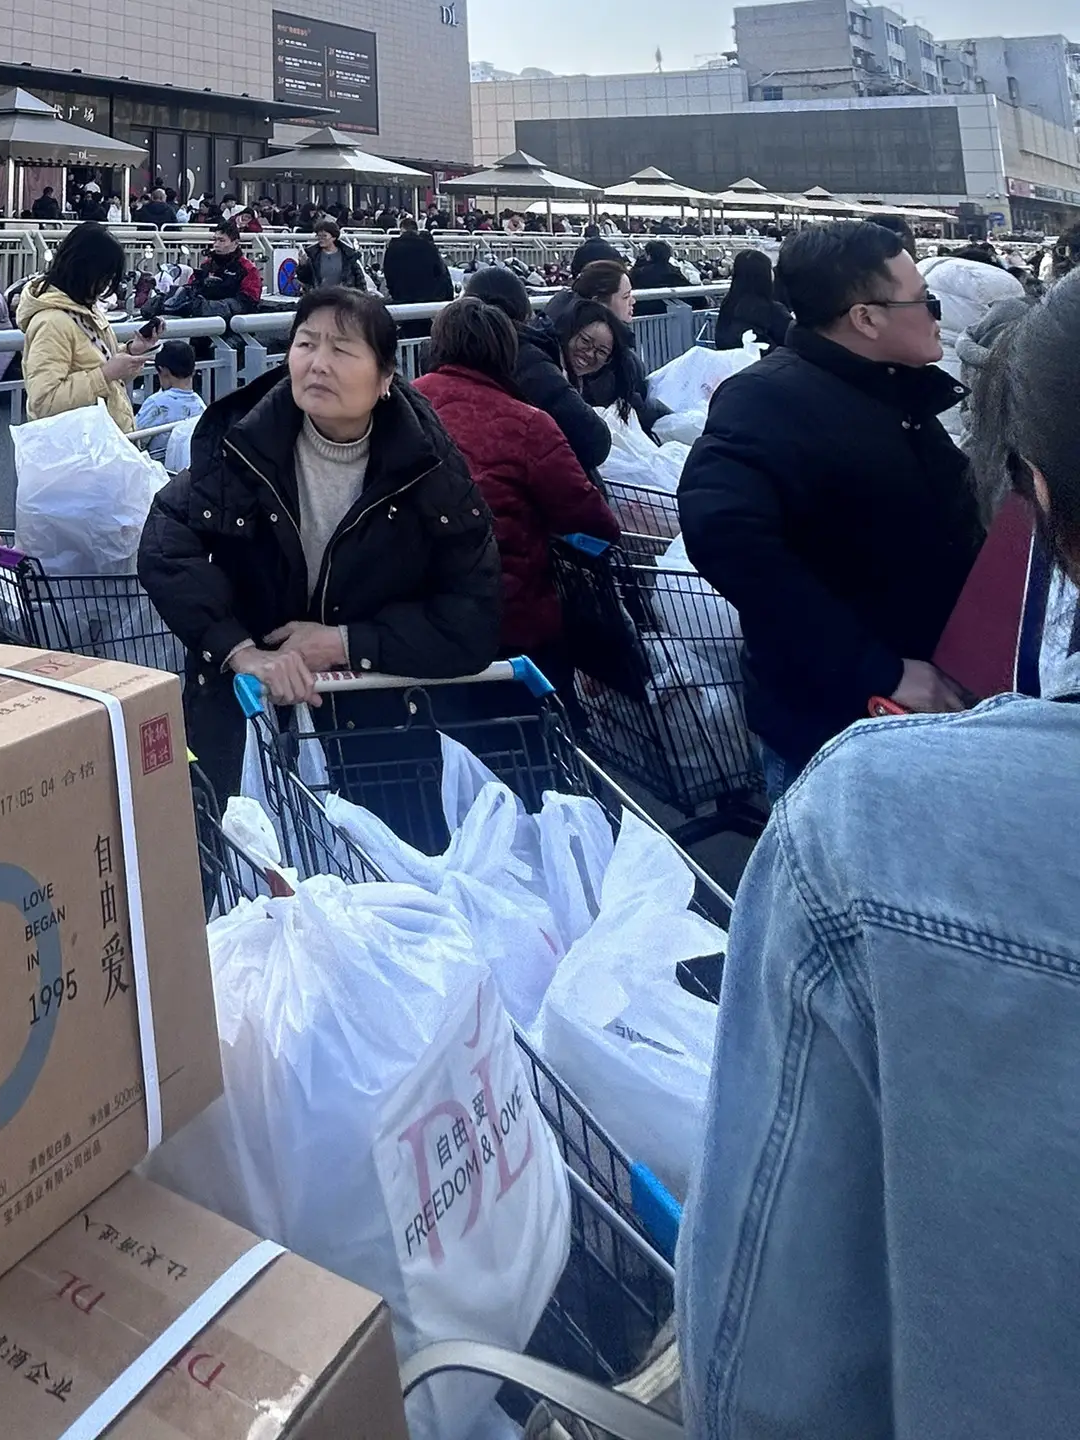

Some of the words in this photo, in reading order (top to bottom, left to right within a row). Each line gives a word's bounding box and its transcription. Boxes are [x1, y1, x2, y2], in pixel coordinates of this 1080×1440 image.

[41, 776, 55, 798] 04
[61, 762, 96, 787] 合格
[23, 882, 55, 913] LOVE
[25, 905, 67, 943] BEGAN
[27, 950, 41, 972] IN
[28, 968, 79, 1026] 1995
[404, 1149, 481, 1257] FREEDOM
[480, 1134, 496, 1165] &
[495, 1083, 524, 1145] LOVE
